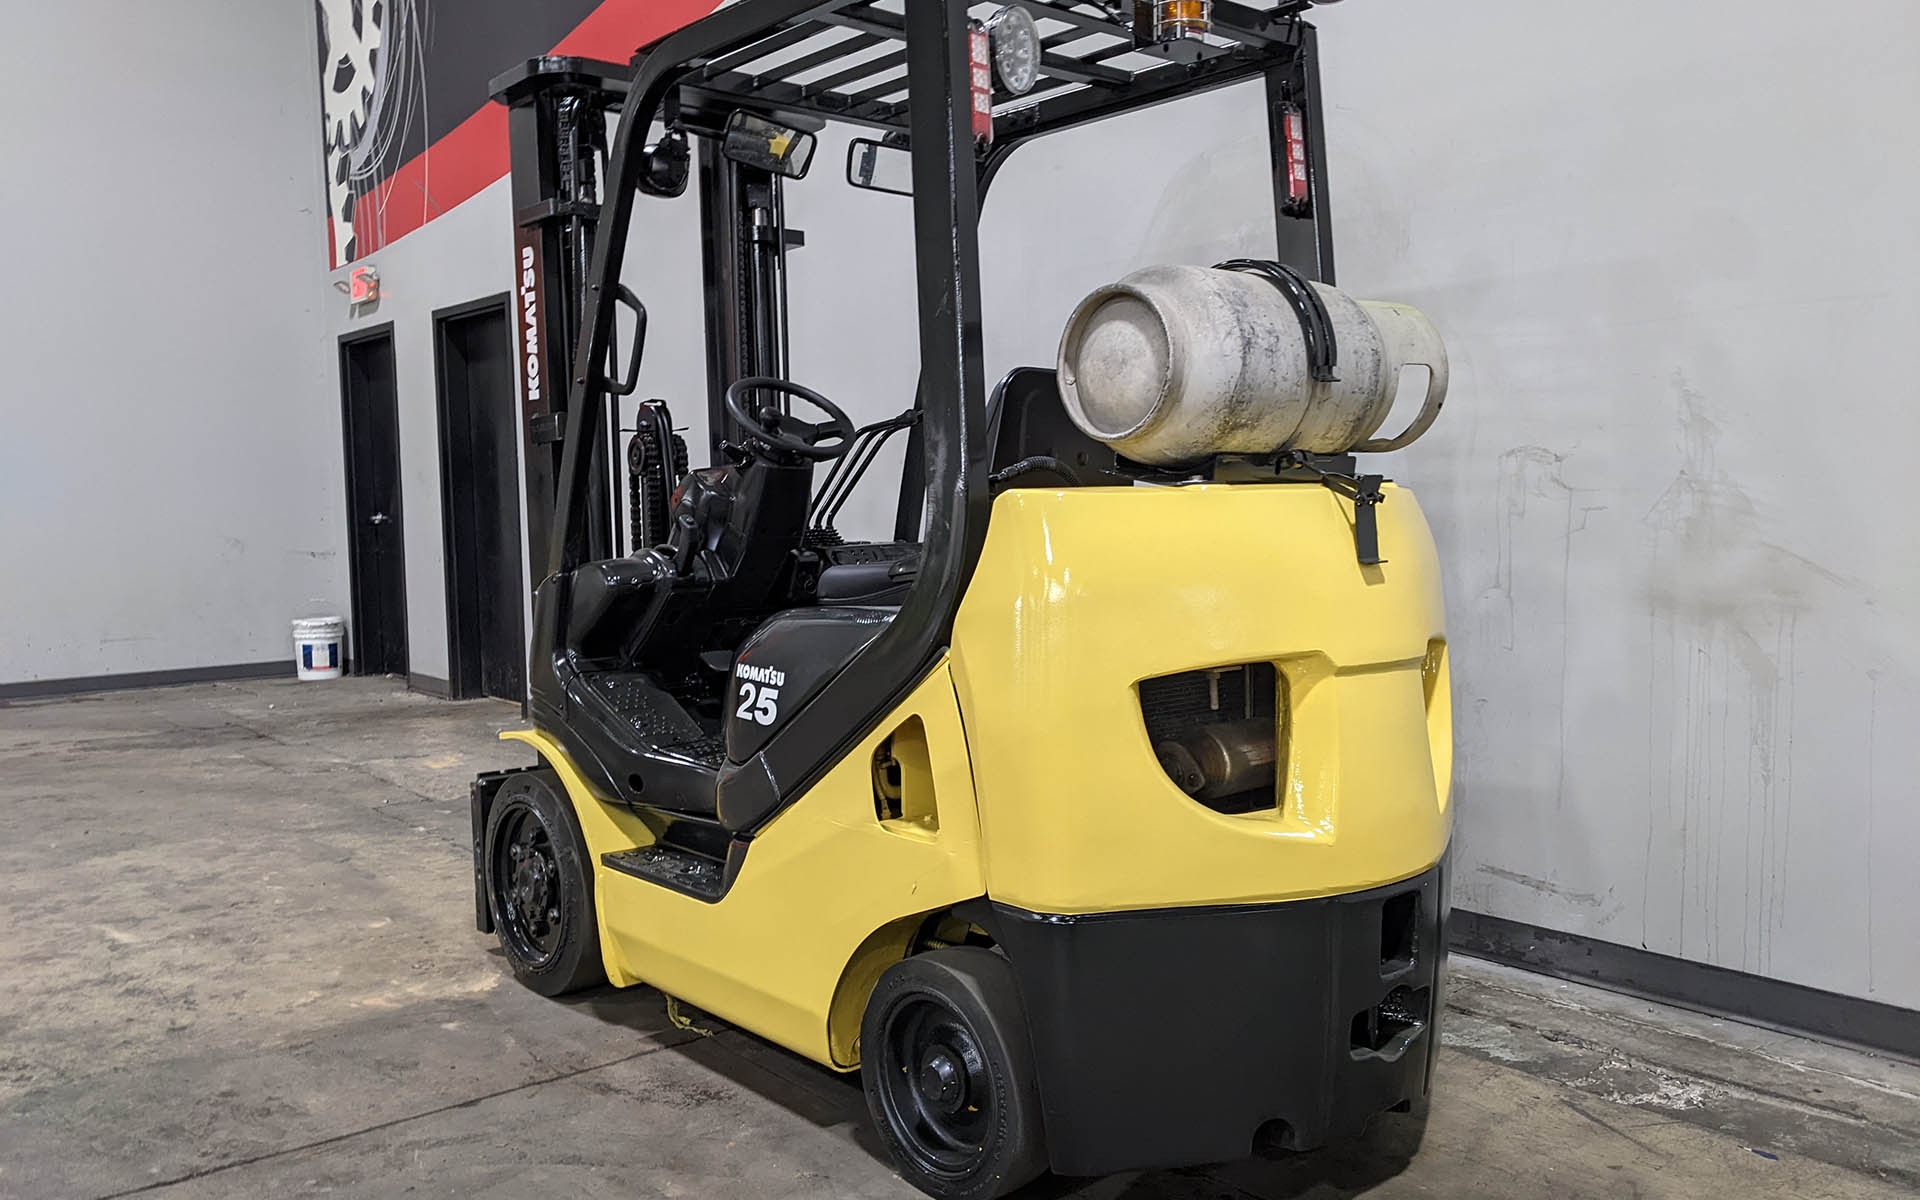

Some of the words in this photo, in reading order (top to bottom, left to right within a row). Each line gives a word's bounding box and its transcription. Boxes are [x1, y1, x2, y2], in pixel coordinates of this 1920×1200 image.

[521, 246, 540, 400] KOMATSU
[736, 663, 785, 686] KOMATSU
[736, 682, 779, 726] 25
